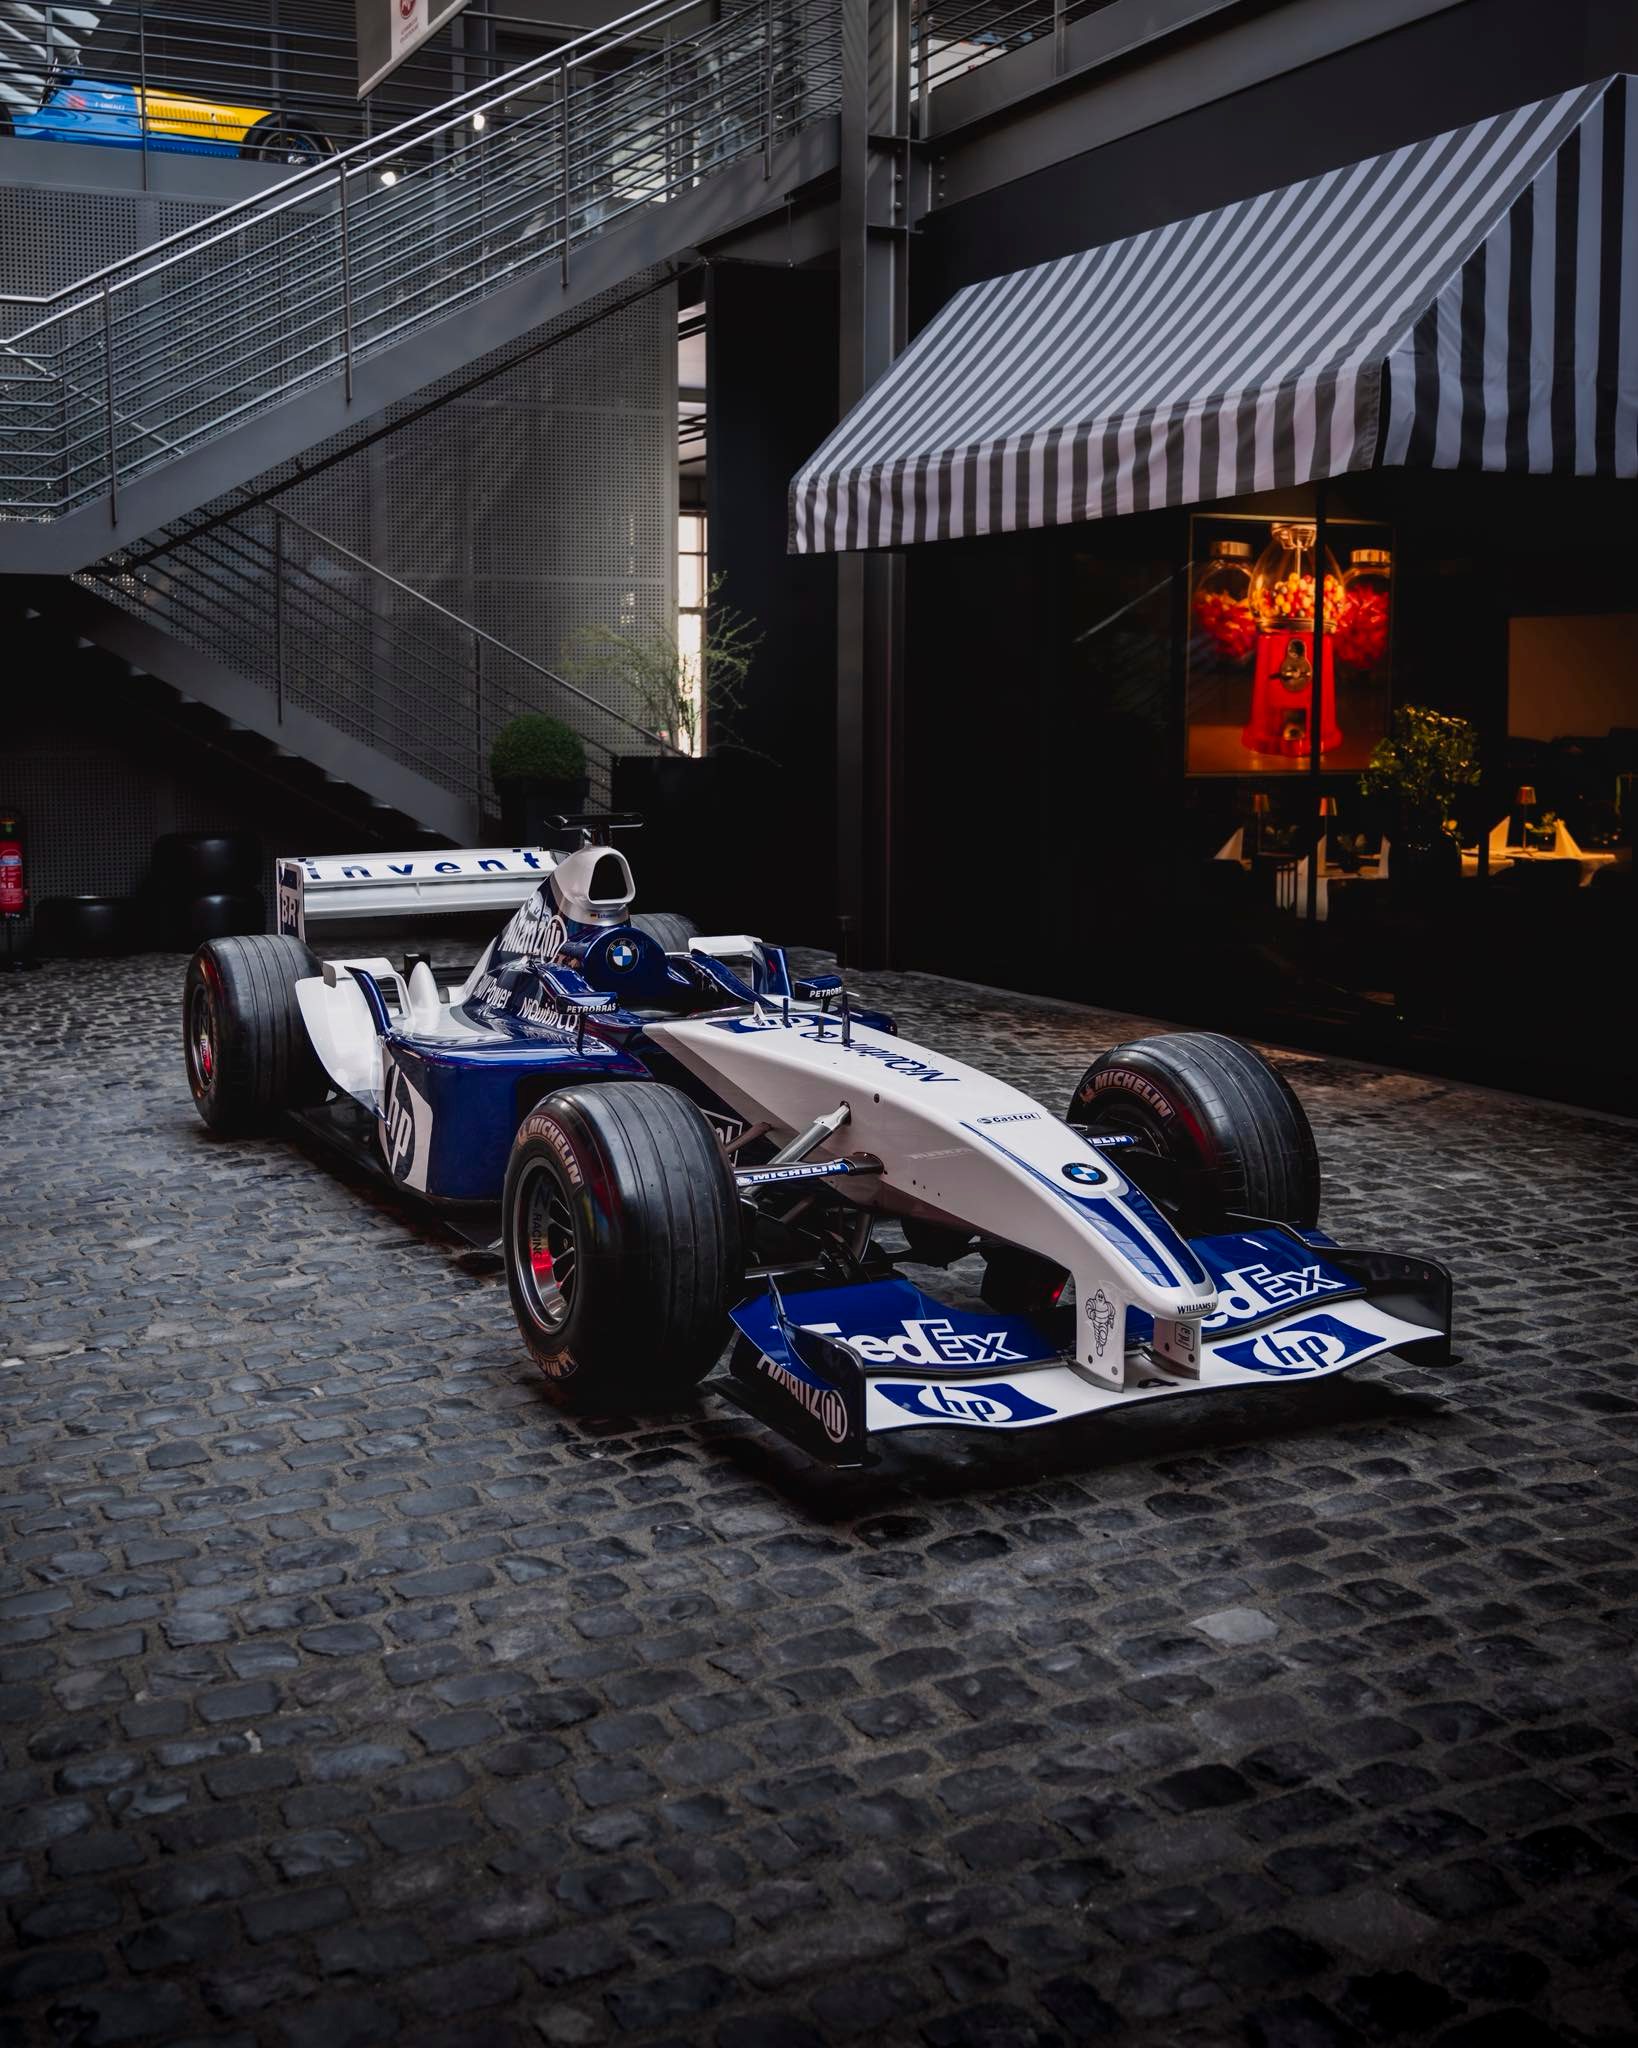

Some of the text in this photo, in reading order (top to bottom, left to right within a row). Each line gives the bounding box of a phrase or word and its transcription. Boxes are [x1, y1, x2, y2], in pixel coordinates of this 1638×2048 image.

[305, 853, 541, 879] invent
[481, 978, 512, 1009] Power
[566, 1002, 617, 1014] PETROBRAS
[1094, 1071, 1172, 1118] MICHELIN
[385, 1063, 413, 1176] hp
[993, 1113, 1037, 1123] Castrol
[527, 1117, 581, 1185] MICHELIN
[1088, 1135, 1127, 1145] ELIN
[752, 1163, 842, 1181] MICHELIN
[532, 1213, 543, 1259] RACING
[1177, 1303, 1211, 1314] WILLIAMS
[1201, 1263, 1347, 1328] dEx
[1261, 1334, 1329, 1369] hp
[931, 1385, 996, 1422] hp
